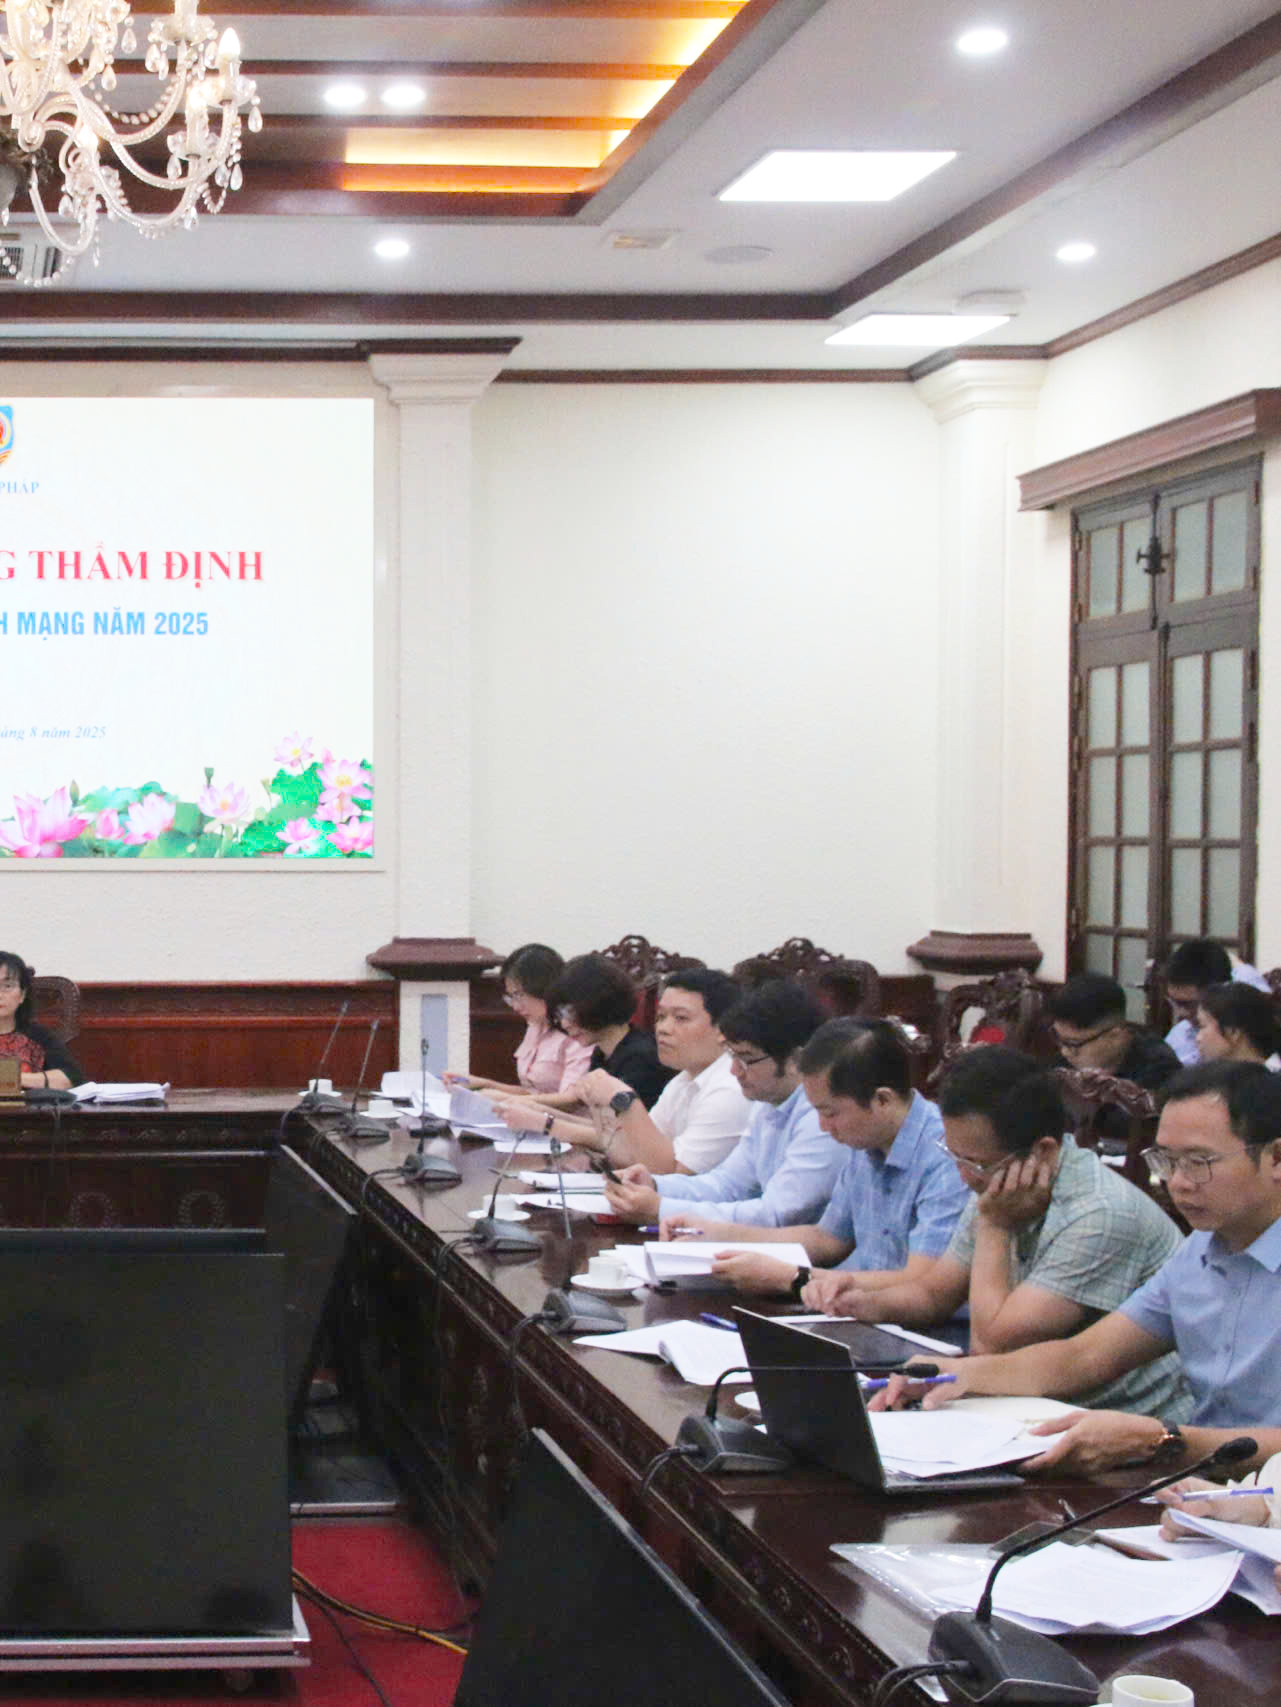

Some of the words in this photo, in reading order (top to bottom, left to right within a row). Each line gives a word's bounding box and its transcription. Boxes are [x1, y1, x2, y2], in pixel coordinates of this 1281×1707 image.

[28, 541, 148, 580] THẨM
[163, 550, 264, 588] ĐỊNH
[17, 611, 85, 641] MẠNG
[93, 606, 145, 635] NĂM
[154, 612, 208, 635] 2025
[74, 725, 106, 737] 2025
